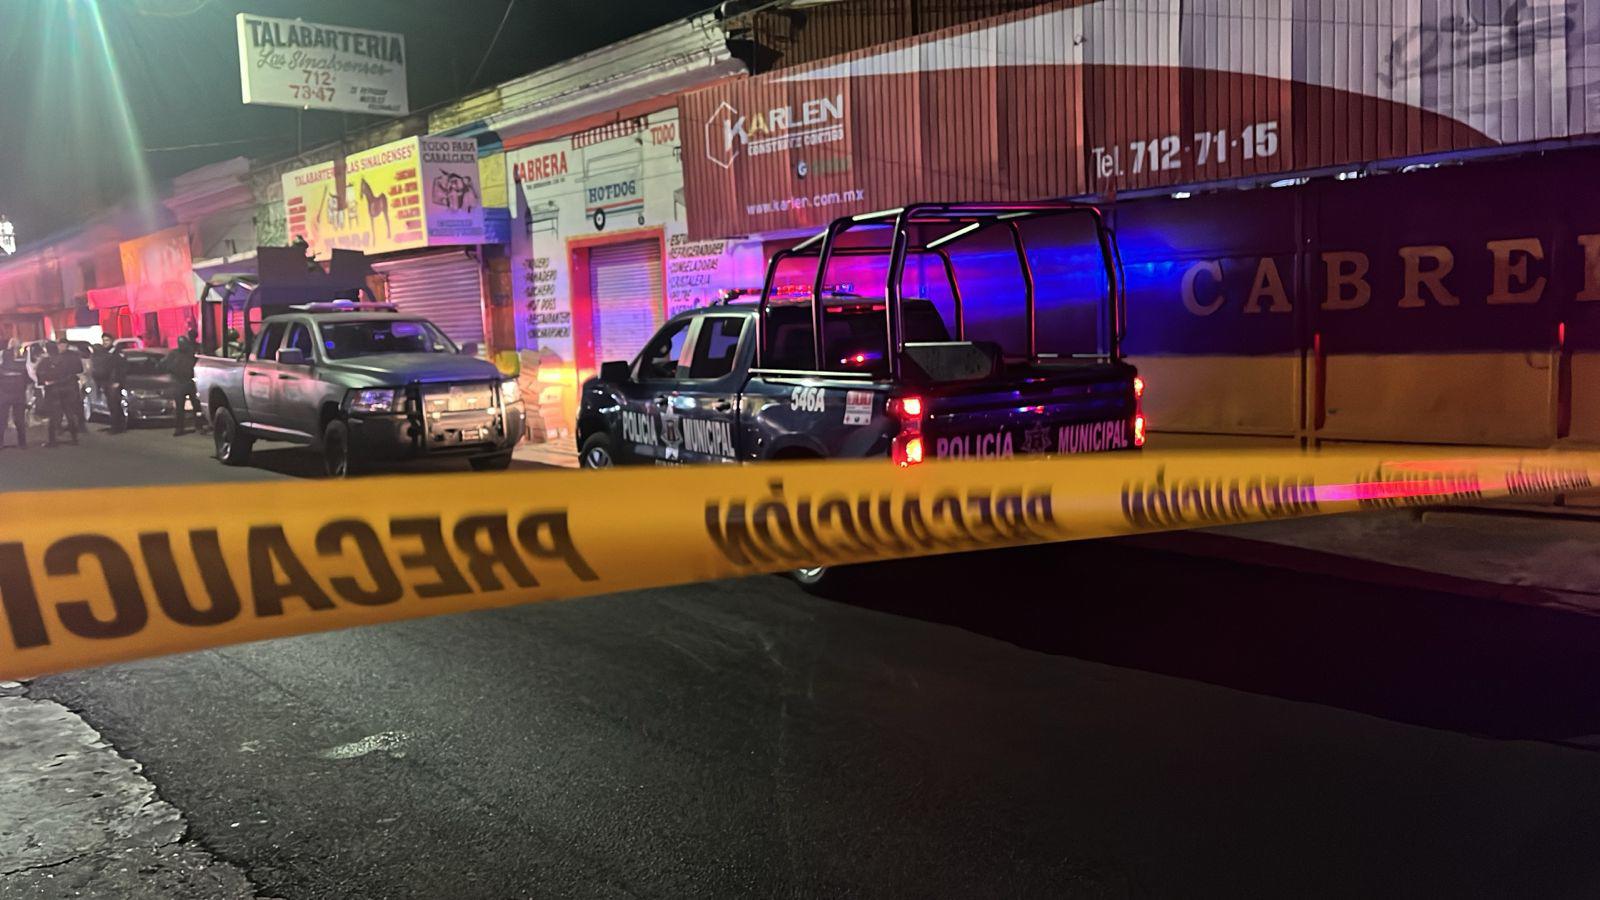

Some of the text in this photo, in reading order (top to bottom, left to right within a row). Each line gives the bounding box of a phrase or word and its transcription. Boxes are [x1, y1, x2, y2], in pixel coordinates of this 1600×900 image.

[246, 19, 403, 65] TALABARTERIA
[651, 123, 675, 145] TODO
[723, 94, 843, 152] KARLEN
[294, 168, 336, 187] TALABARTE
[1092, 147, 1124, 178] Tel.
[791, 386, 826, 412] 546A
[683, 418, 736, 457] MUNICIPAL
[936, 419, 1129, 460] POLICÍA MUNICIPAL
